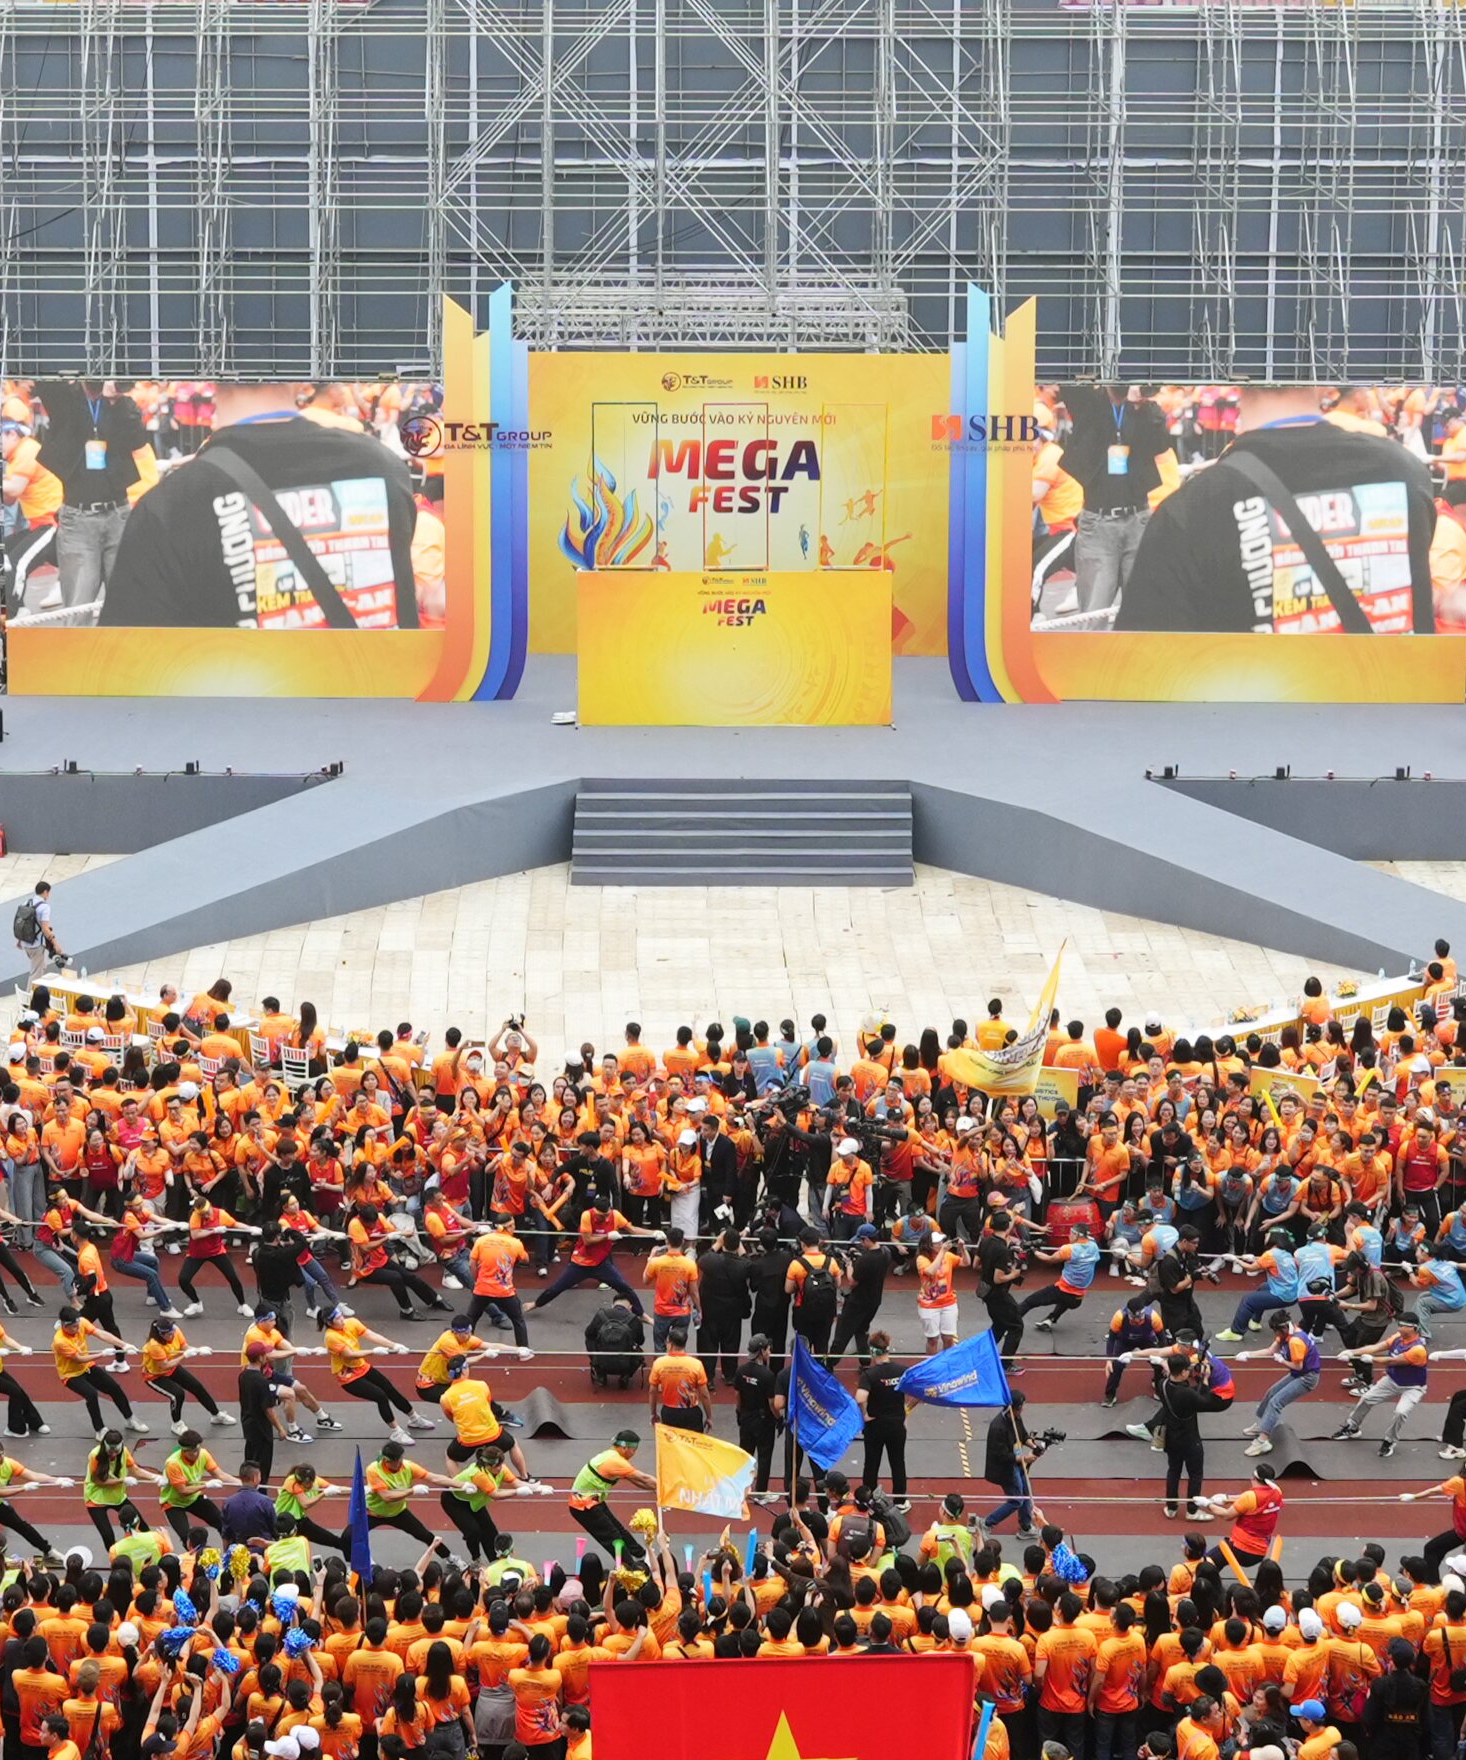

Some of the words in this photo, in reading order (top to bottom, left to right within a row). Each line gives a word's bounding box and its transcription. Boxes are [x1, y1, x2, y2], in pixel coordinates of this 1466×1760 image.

[772, 375, 807, 389] SHB
[633, 411, 668, 424] VỮNG
[672, 411, 705, 424] BƯỚC
[710, 411, 734, 424] VÀO
[758, 411, 808, 424] NGUYÊN
[811, 411, 837, 424] MỚI
[444, 423, 499, 441] T&T
[497, 431, 552, 441] GROUP
[968, 415, 1040, 441] SHB
[647, 439, 821, 481] MEGA
[689, 486, 789, 514] FEST
[703, 598, 766, 615] MEGA
[717, 615, 755, 627] FEST
[938, 1370, 979, 1393] Vinawind
